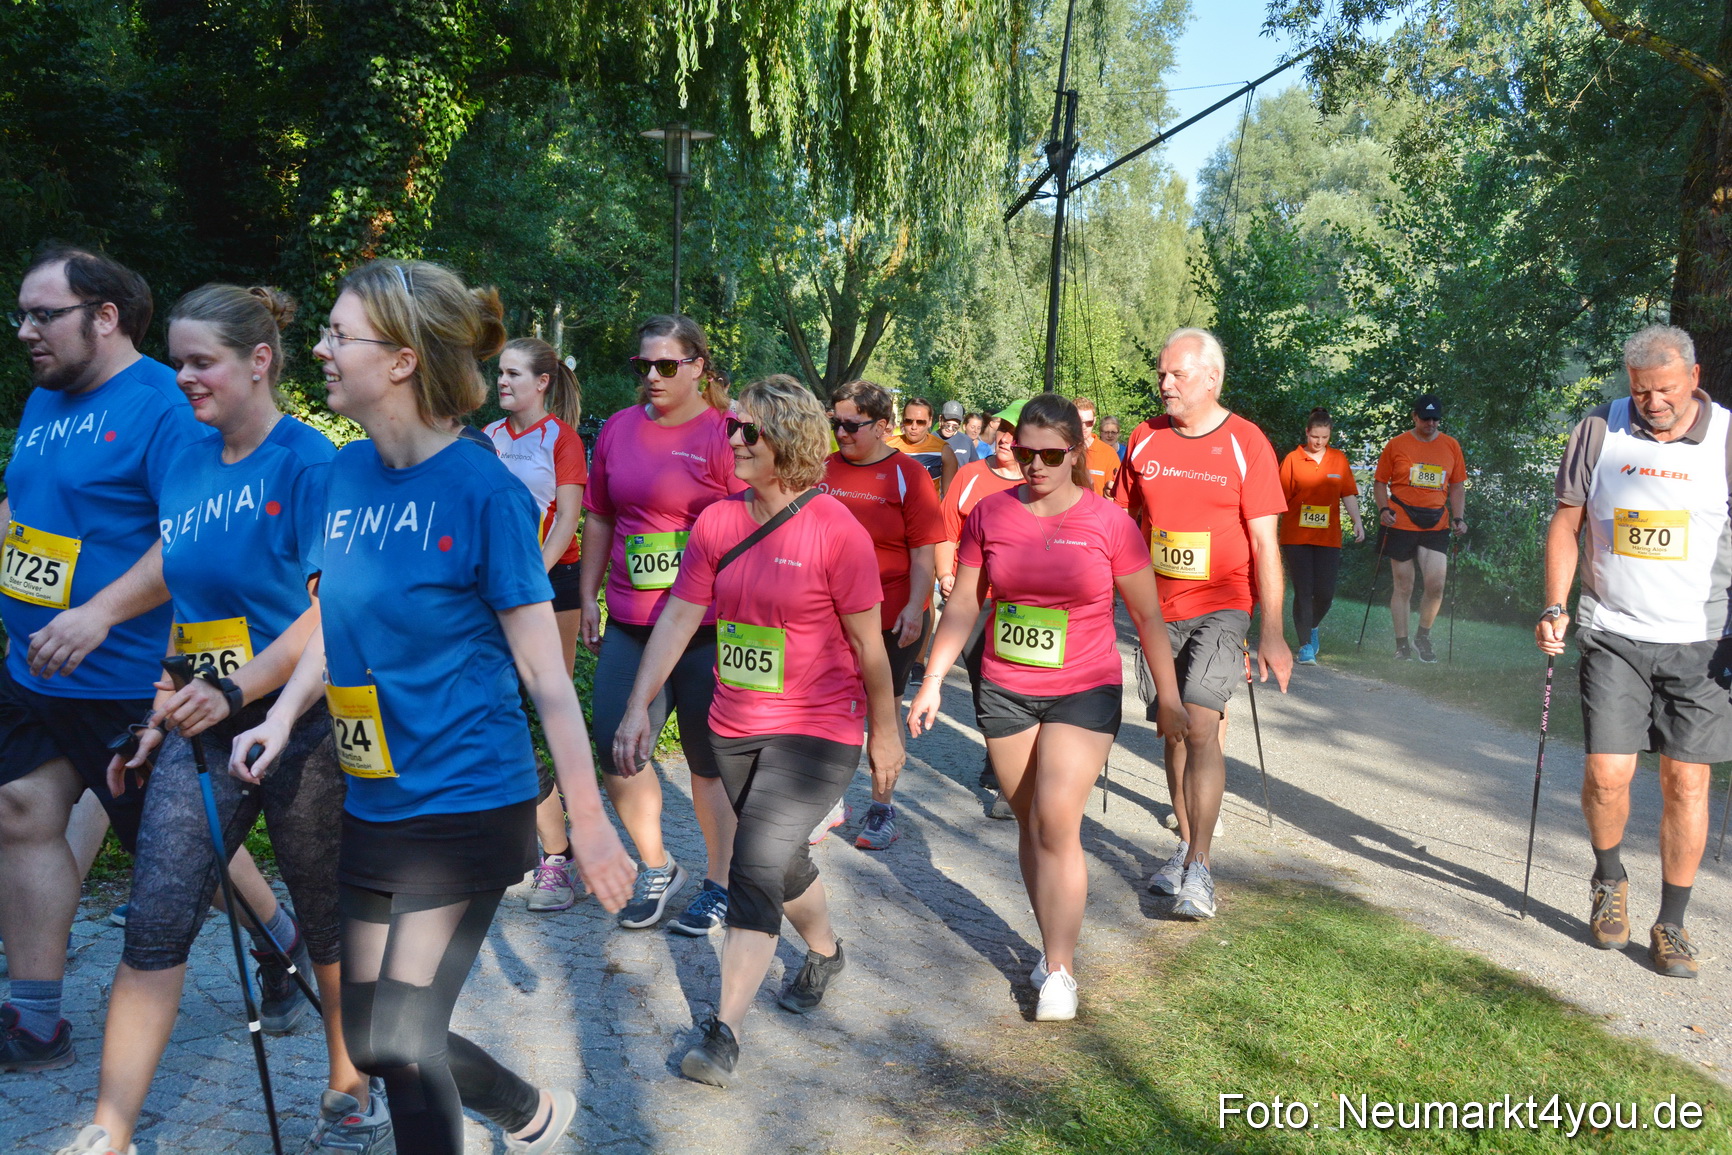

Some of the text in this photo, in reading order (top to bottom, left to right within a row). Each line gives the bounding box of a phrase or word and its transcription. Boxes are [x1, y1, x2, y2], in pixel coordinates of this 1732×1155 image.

[1162, 467, 1227, 486] bfwnürnberg
[1418, 472, 1435, 481] 888
[1639, 467, 1692, 481] KLEBL
[830, 488, 886, 504] bfwnürnberg
[1304, 513, 1326, 522] 1484
[1629, 528, 1671, 547] 870
[632, 552, 681, 574] 2064
[1161, 547, 1194, 566] 109
[6, 548, 61, 587] 1725
[1001, 623, 1054, 650] 2083
[723, 644, 772, 673] 2065
